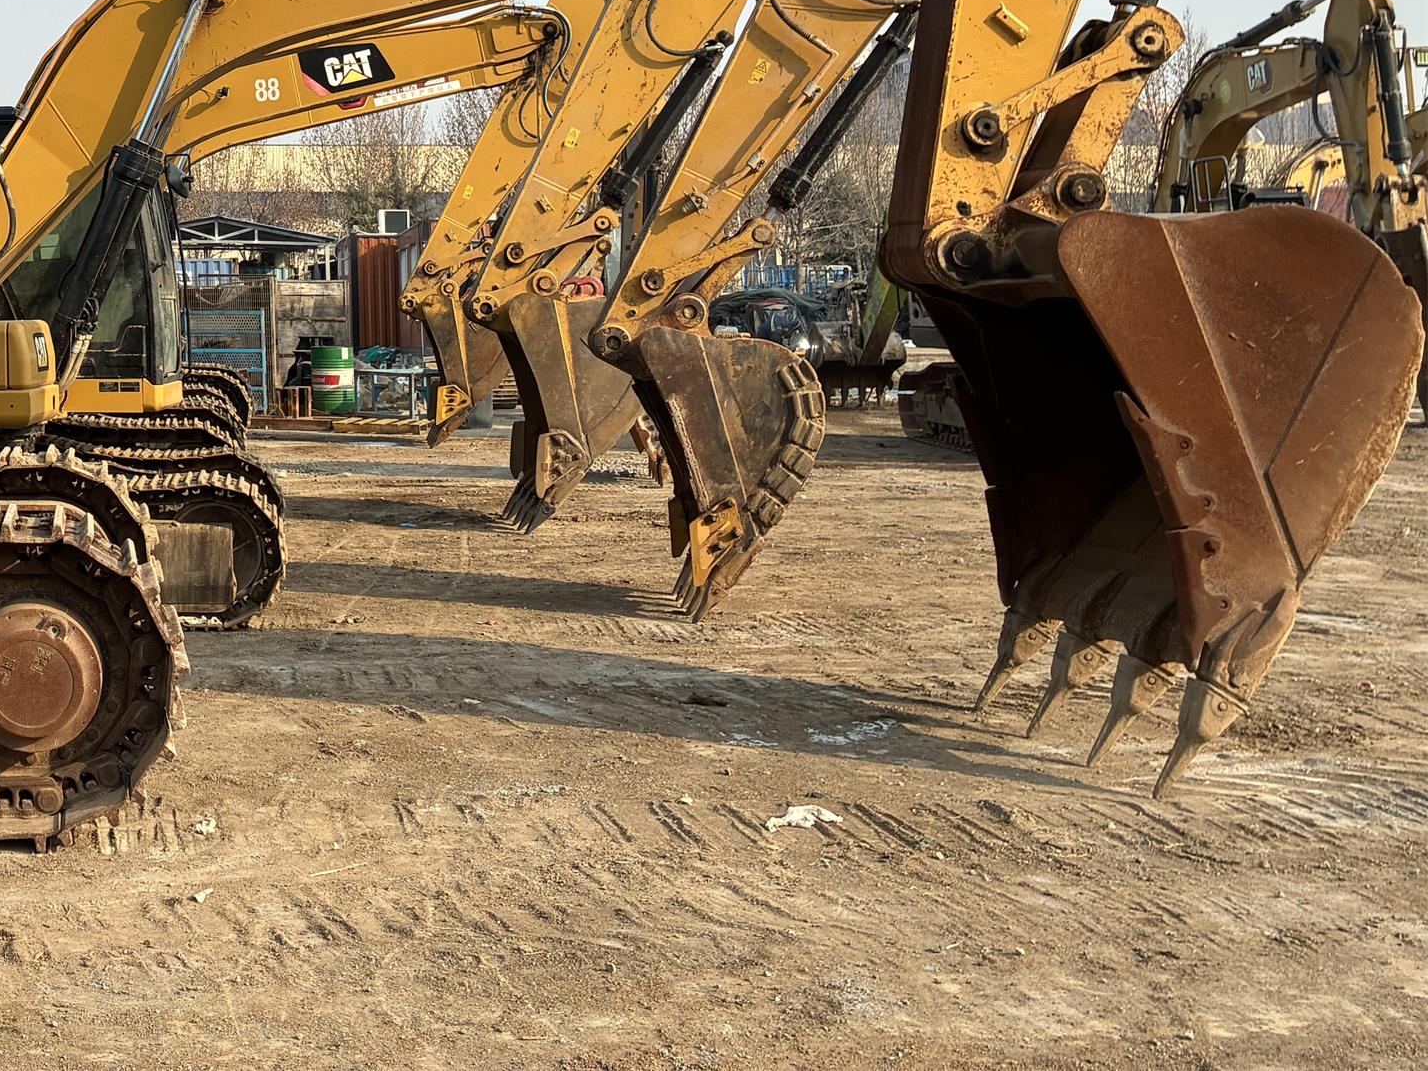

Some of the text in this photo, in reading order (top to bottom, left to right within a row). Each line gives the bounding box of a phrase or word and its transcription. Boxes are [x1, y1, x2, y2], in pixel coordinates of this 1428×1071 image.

[324, 48, 373, 87] CAT
[1247, 59, 1267, 92] CAT
[254, 77, 281, 102] 88
